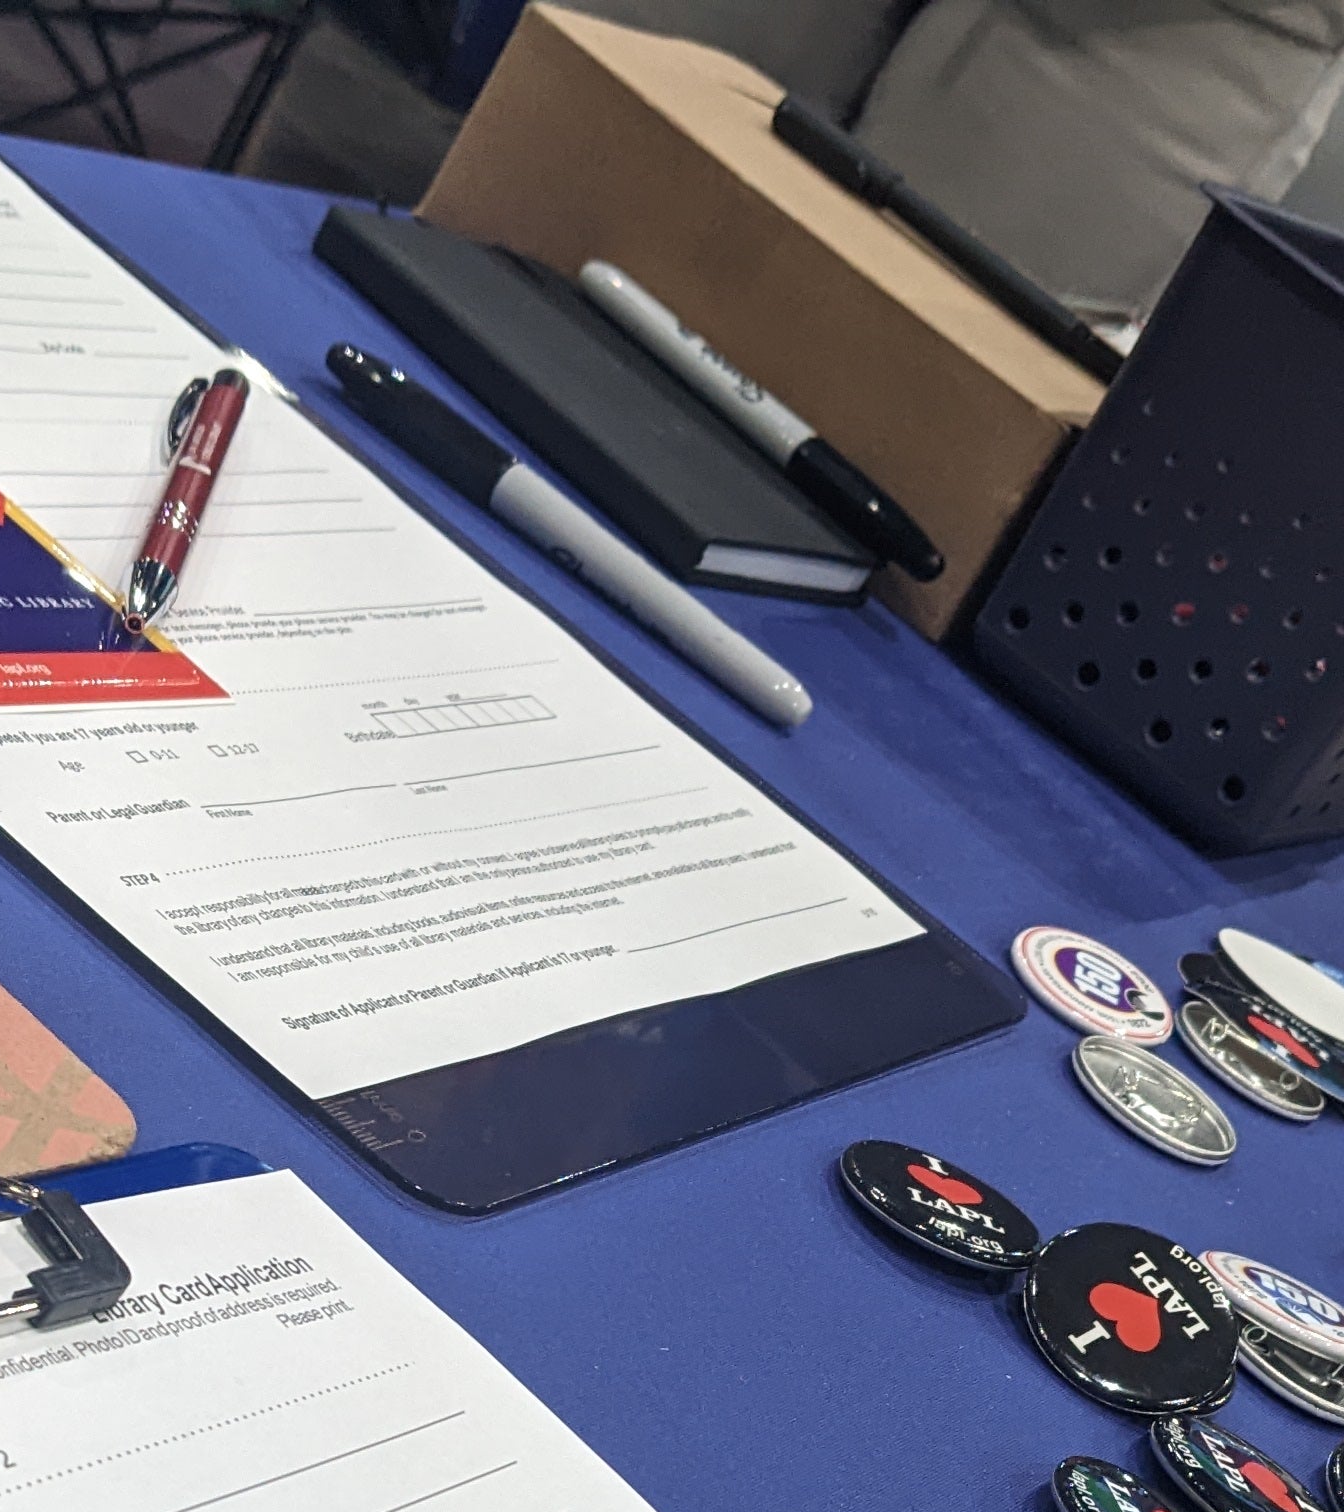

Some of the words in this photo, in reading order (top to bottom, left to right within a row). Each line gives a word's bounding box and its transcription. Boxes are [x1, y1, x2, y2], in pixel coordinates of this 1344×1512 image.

[19, 596, 95, 610] LIBRARY
[21, 731, 31, 744] if
[31, 733, 52, 746] you
[54, 731, 72, 742] are
[72, 727, 90, 740] 17
[91, 726, 124, 740] years
[124, 722, 142, 735] old
[142, 723, 156, 734] or
[156, 720, 199, 735] younger
[148, 748, 181, 761] 0-11
[227, 742, 260, 756] 12-17
[57, 760, 86, 774] Age
[46, 808, 90, 824] Parent
[90, 807, 106, 820] or
[104, 803, 139, 820] Legal
[137, 798, 192, 816] Guardian
[119, 873, 150, 887] STEP
[150, 872, 161, 884] 4
[1074, 951, 1124, 1006] 150
[921, 1154, 950, 1176] I
[906, 1187, 1006, 1234] LAPL
[928, 1215, 1004, 1254] lapl.org
[158, 1273, 209, 1306] Card
[207, 1256, 314, 1297] Application
[1168, 1244, 1224, 1310] lapl.org
[276, 1308, 323, 1328] Please
[1067, 1321, 1112, 1355] I
[1129, 1251, 1211, 1339] LAPL
[1249, 1270, 1344, 1327] 150
[73, 1334, 123, 1357] Photo
[122, 1328, 141, 1345] ID
[139, 1322, 169, 1341] and
[167, 1311, 205, 1337] proof
[204, 1308, 220, 1323] of
[217, 1292, 273, 1321] address
[267, 1293, 286, 1306] is
[1200, 1431, 1250, 1493] LAPL
